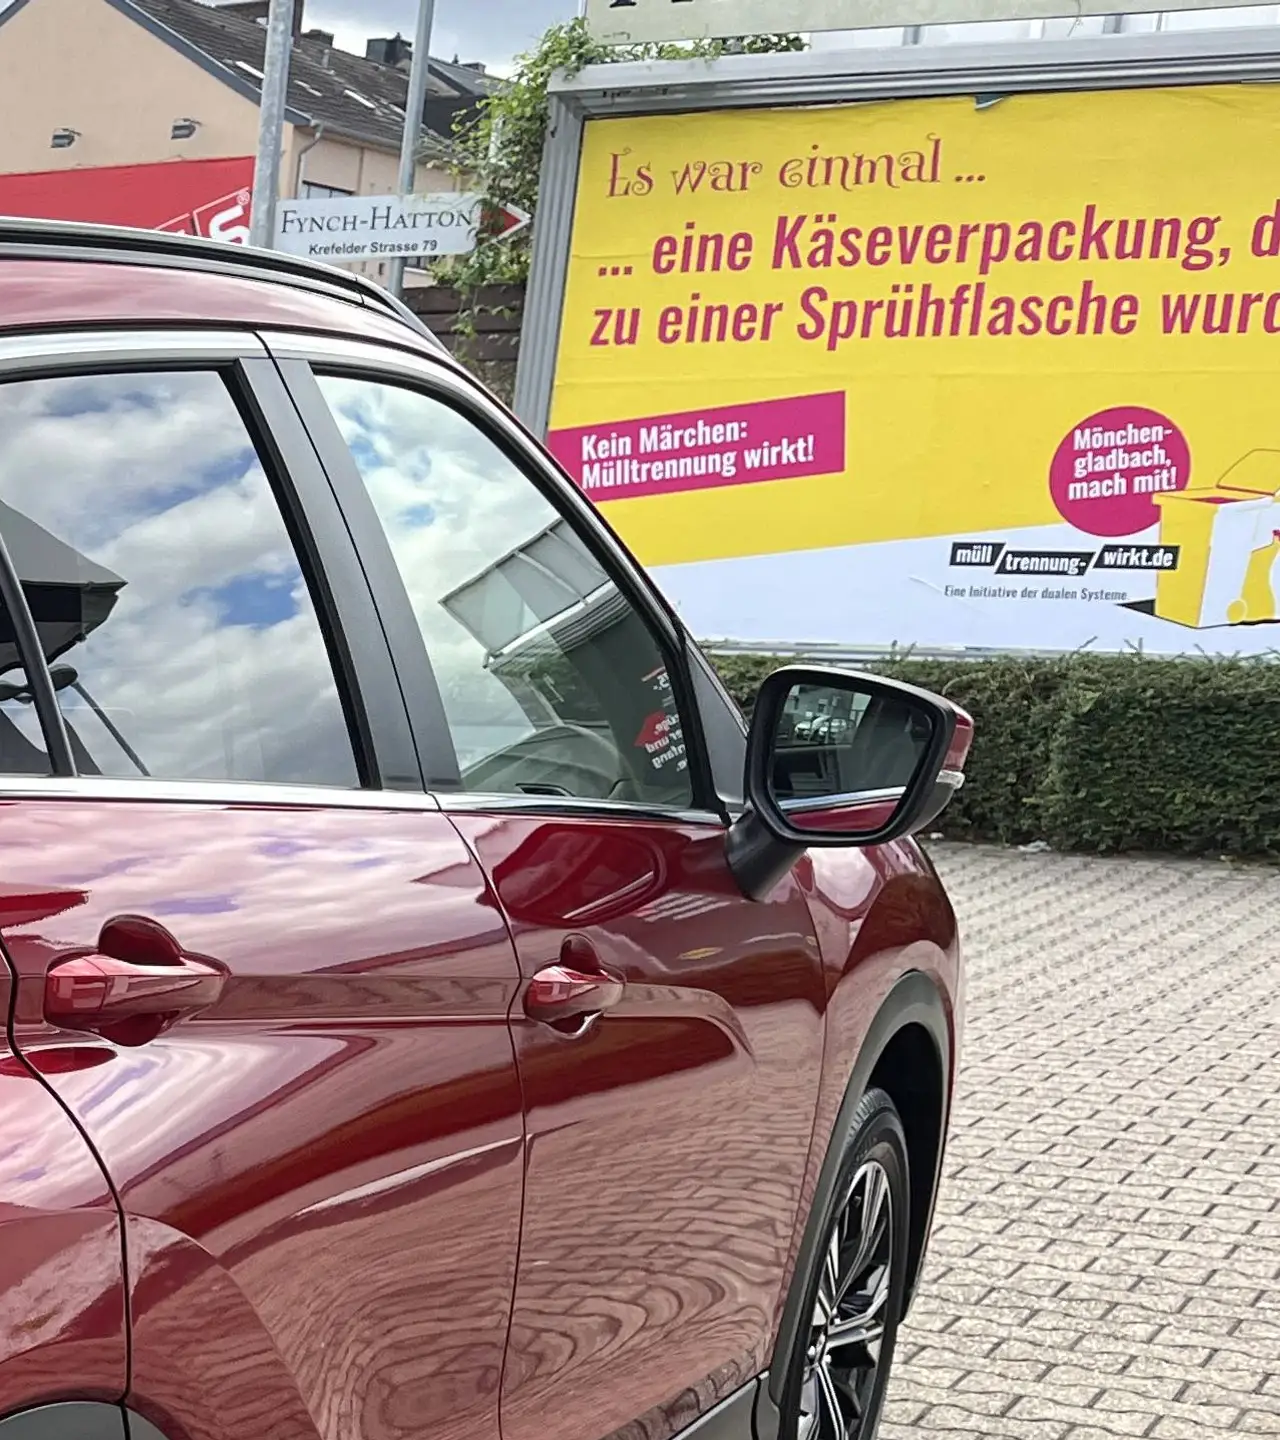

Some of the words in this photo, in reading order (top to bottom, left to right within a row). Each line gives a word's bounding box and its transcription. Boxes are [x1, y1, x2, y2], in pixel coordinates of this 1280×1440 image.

[606, 147, 654, 198] Es
[671, 160, 763, 196] war
[779, 133, 942, 191] einmal
[281, 206, 472, 234] FYNCH-HATTON
[309, 242, 366, 256] Krefelder
[370, 241, 418, 253] Strasse
[422, 239, 438, 251] 79
[651, 221, 753, 275] eine
[771, 204, 1231, 276] Käseverpackung,
[589, 307, 641, 346] zu
[658, 293, 784, 344] einer
[797, 280, 1139, 351] Sprühflasche
[581, 432, 632, 462] Kein
[639, 419, 748, 454] Märchen:
[1074, 423, 1173, 451] Mönchen-
[581, 449, 738, 490] Mülltrennung
[744, 434, 815, 470] wirkt!
[1074, 444, 1172, 478] gladbach,
[1068, 472, 1127, 501] mach
[1133, 466, 1177, 493] mit!
[955, 544, 992, 564] müll
[1004, 553, 1087, 575] trennung-
[1103, 548, 1173, 567] wirkt.de
[944, 585, 966, 598] Eine
[969, 585, 1018, 598] Initiative
[1021, 587, 1038, 599] der
[1041, 587, 1077, 600] dualen
[1081, 587, 1127, 602] Systeme
